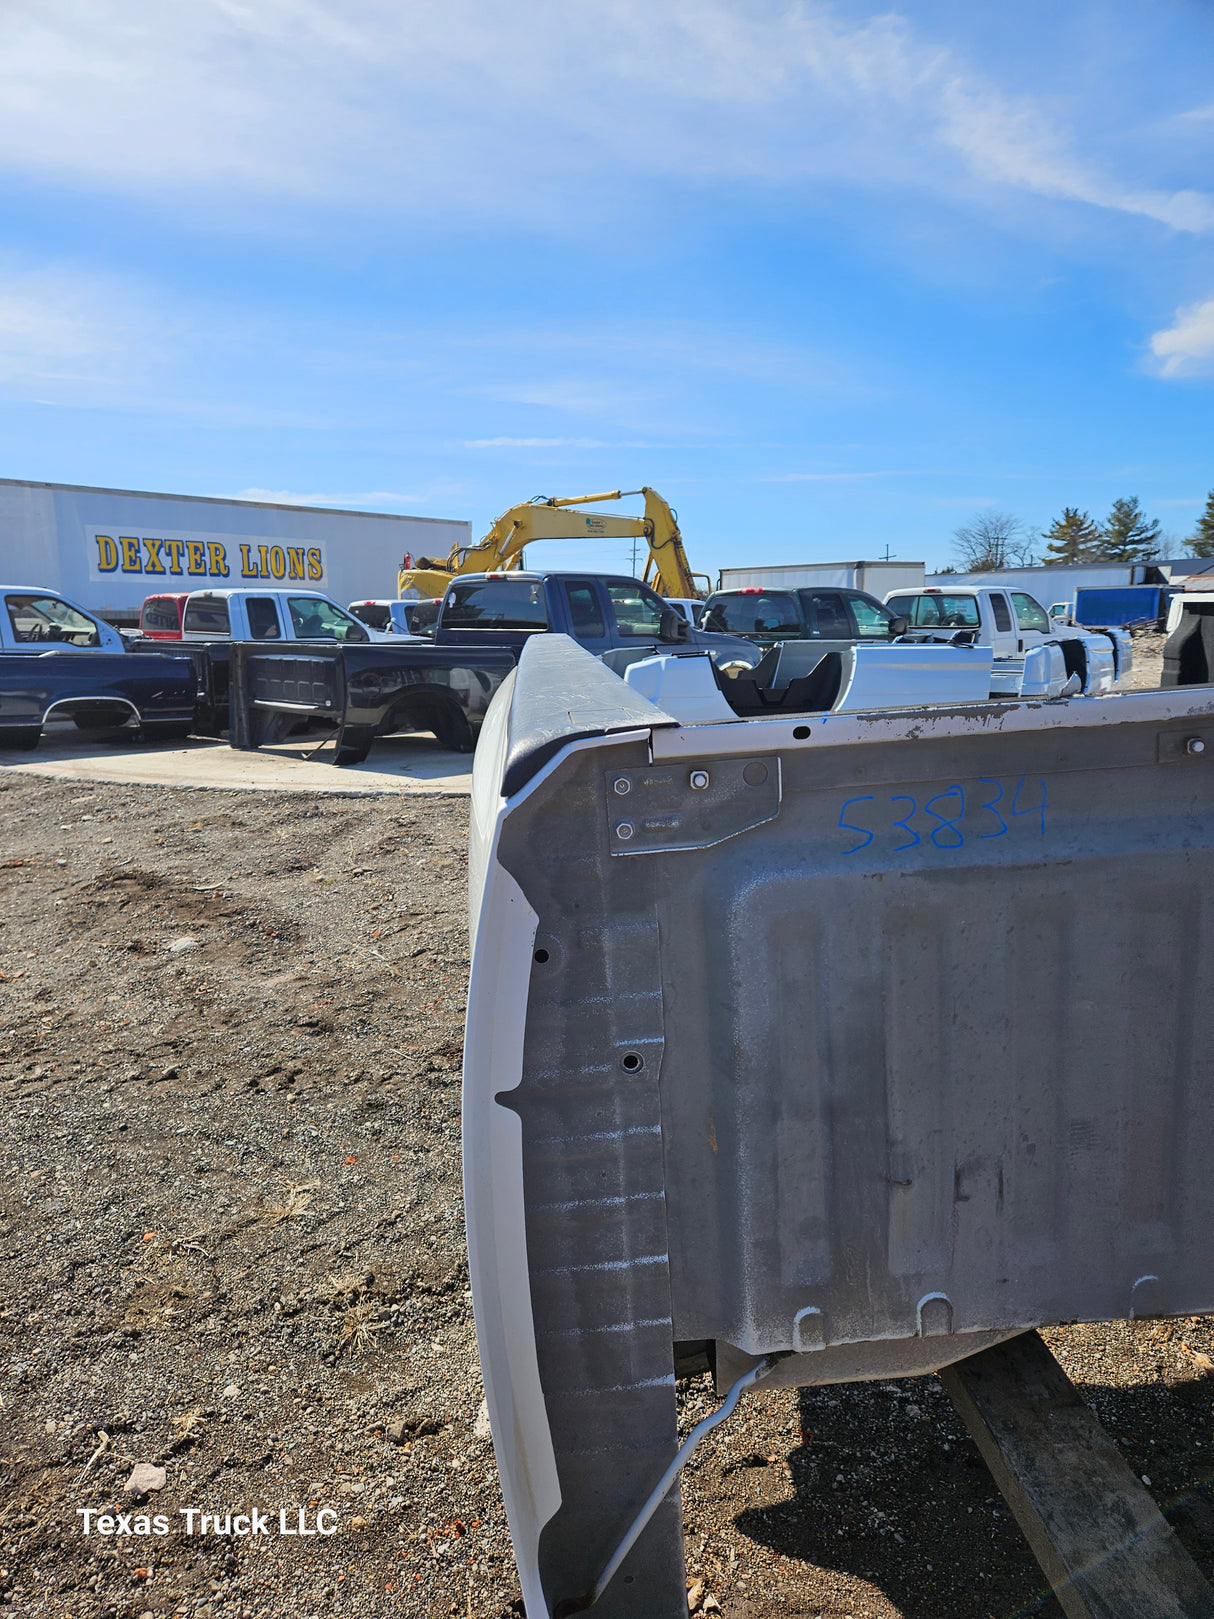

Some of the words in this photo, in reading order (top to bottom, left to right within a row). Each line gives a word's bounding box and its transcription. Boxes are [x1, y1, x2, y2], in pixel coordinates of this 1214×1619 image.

[95, 535, 230, 577] DEXTER
[239, 543, 323, 580] LIONS
[838, 775, 1050, 855] 53834
